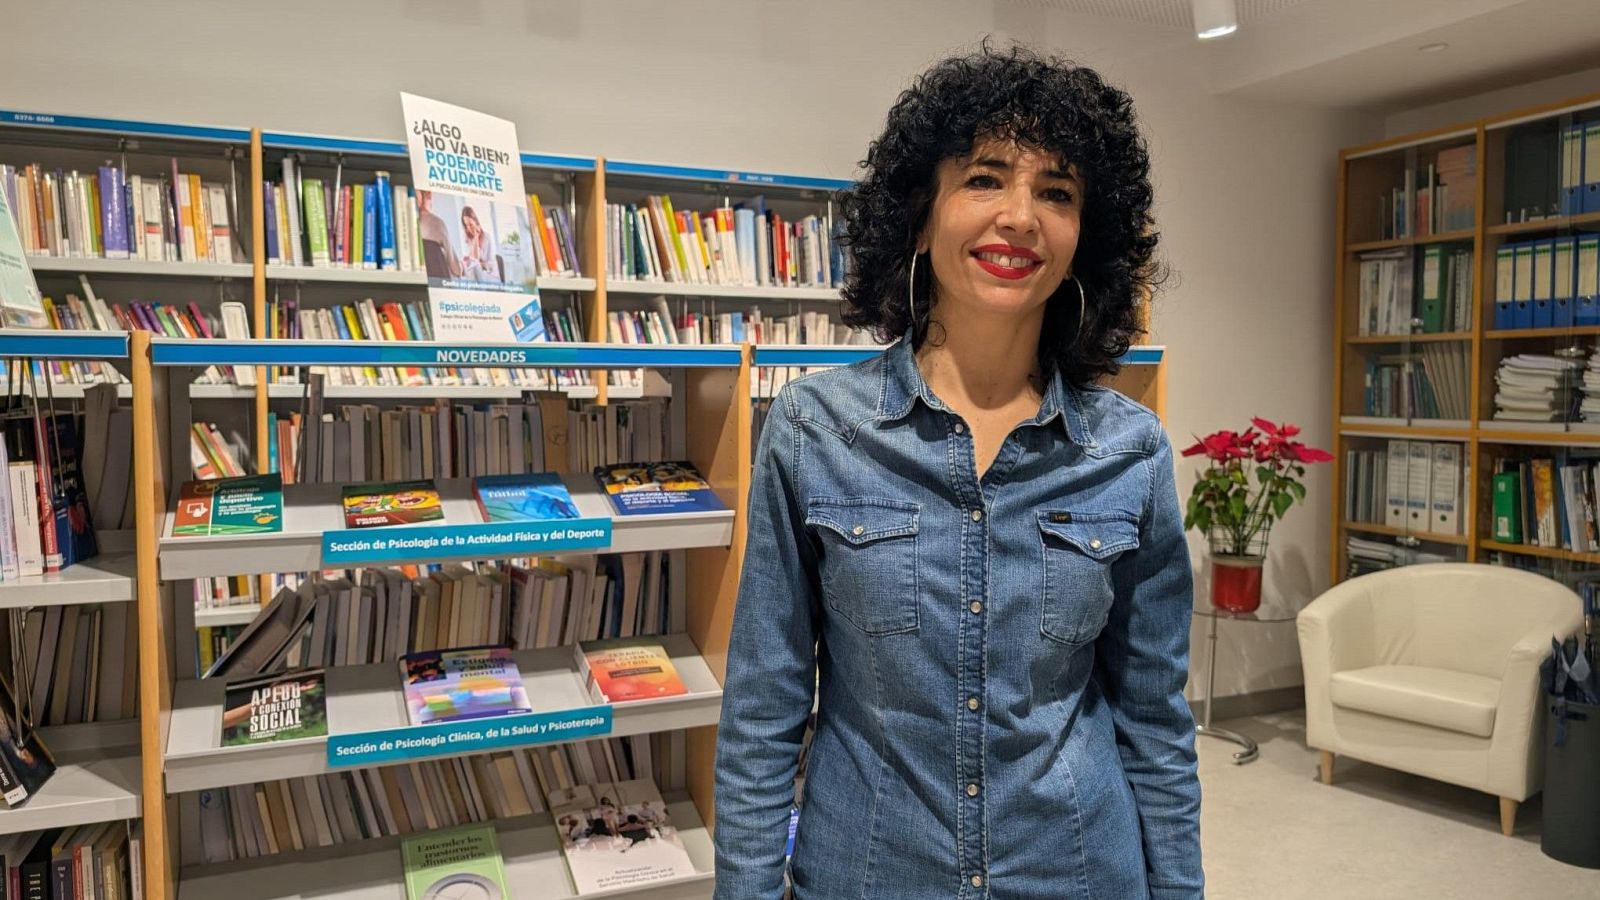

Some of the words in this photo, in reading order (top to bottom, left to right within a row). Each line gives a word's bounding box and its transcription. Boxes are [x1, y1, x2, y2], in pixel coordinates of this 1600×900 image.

[413, 119, 462, 140] ¿ALGO
[423, 134, 446, 151] NO
[449, 139, 470, 157] VA
[473, 145, 510, 166] BIEN?
[425, 150, 496, 176] PODEMOS
[428, 166, 503, 192] AYUDARTE
[439, 301, 502, 314] #psicolegiada
[436, 350, 526, 363] NOVEDADES
[330, 540, 370, 552] Sección
[372, 539, 386, 550] de
[389, 537, 439, 549] Psicología
[441, 536, 454, 546] de
[456, 535, 465, 545] la
[467, 532, 513, 545] Actividad
[515, 531, 540, 542] Física
[542, 532, 549, 542] y
[550, 530, 565, 540] del
[567, 529, 605, 541] Deporte
[460, 668, 506, 678] mental
[250, 708, 302, 732] SOCIAL
[251, 706, 257, 716] Y
[336, 742, 377, 756] Sección
[379, 741, 393, 751] de
[395, 735, 446, 749] Psicología
[448, 731, 484, 742] Clínica,
[486, 728, 499, 738] de
[501, 727, 510, 737] la
[511, 723, 539, 736] Salud
[540, 724, 547, 734] y
[549, 716, 605, 731] Psicoterapia
[417, 838, 465, 852] Entender
[467, 836, 482, 844] los
[420, 851, 486, 868] alimentarios
